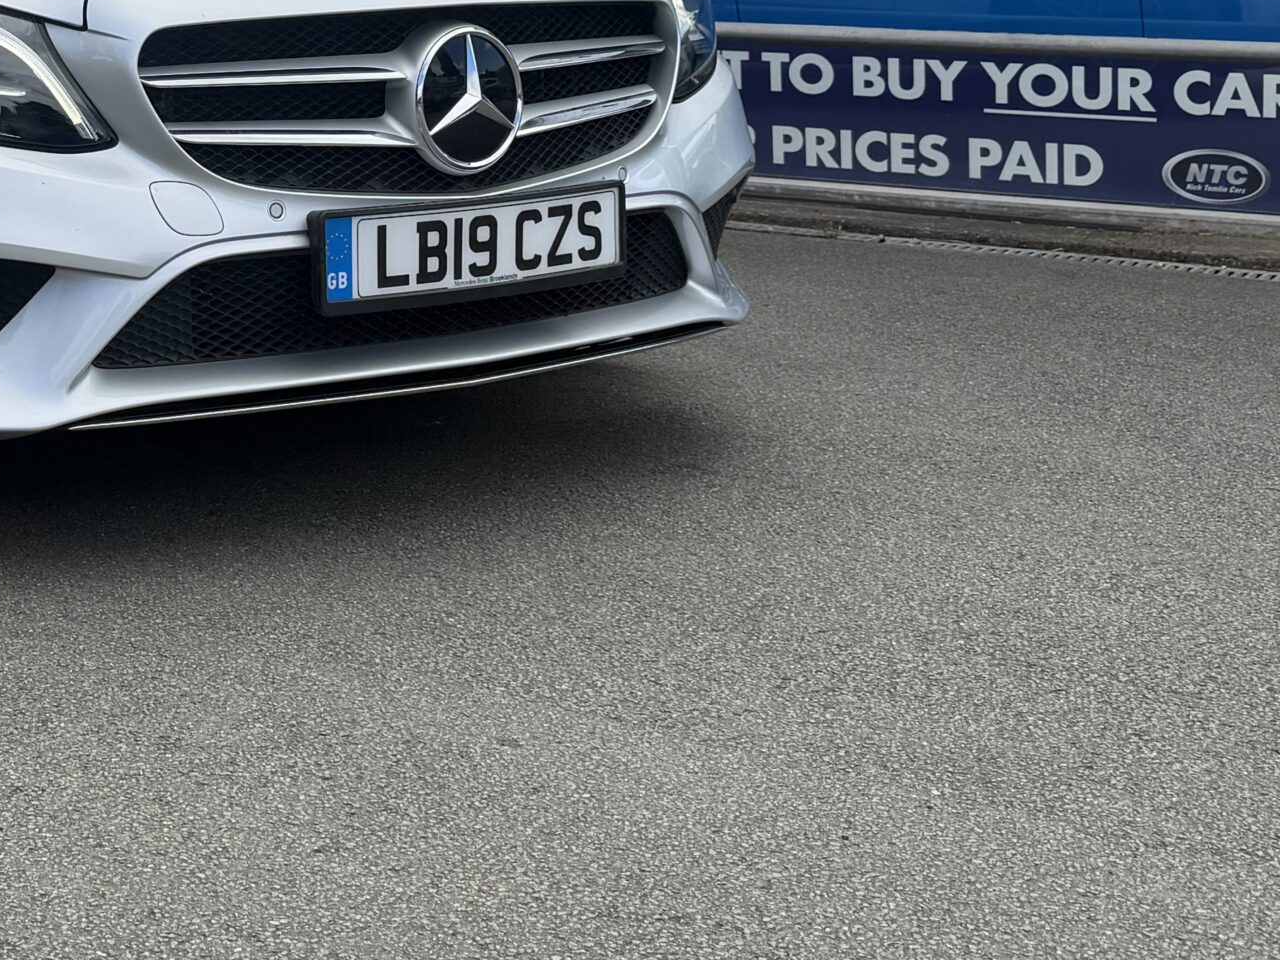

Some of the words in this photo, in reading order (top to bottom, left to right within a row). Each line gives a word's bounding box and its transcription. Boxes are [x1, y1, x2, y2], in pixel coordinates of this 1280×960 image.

[761, 51, 834, 95] TO
[852, 55, 968, 102] BUY
[979, 62, 1157, 114] YOUR
[772, 125, 951, 178] PRICES
[968, 138, 1104, 188] PAID
[1185, 162, 1249, 186] NTC
[376, 213, 499, 289] LB19
[515, 199, 602, 272] CZS
[327, 270, 348, 290] GB
